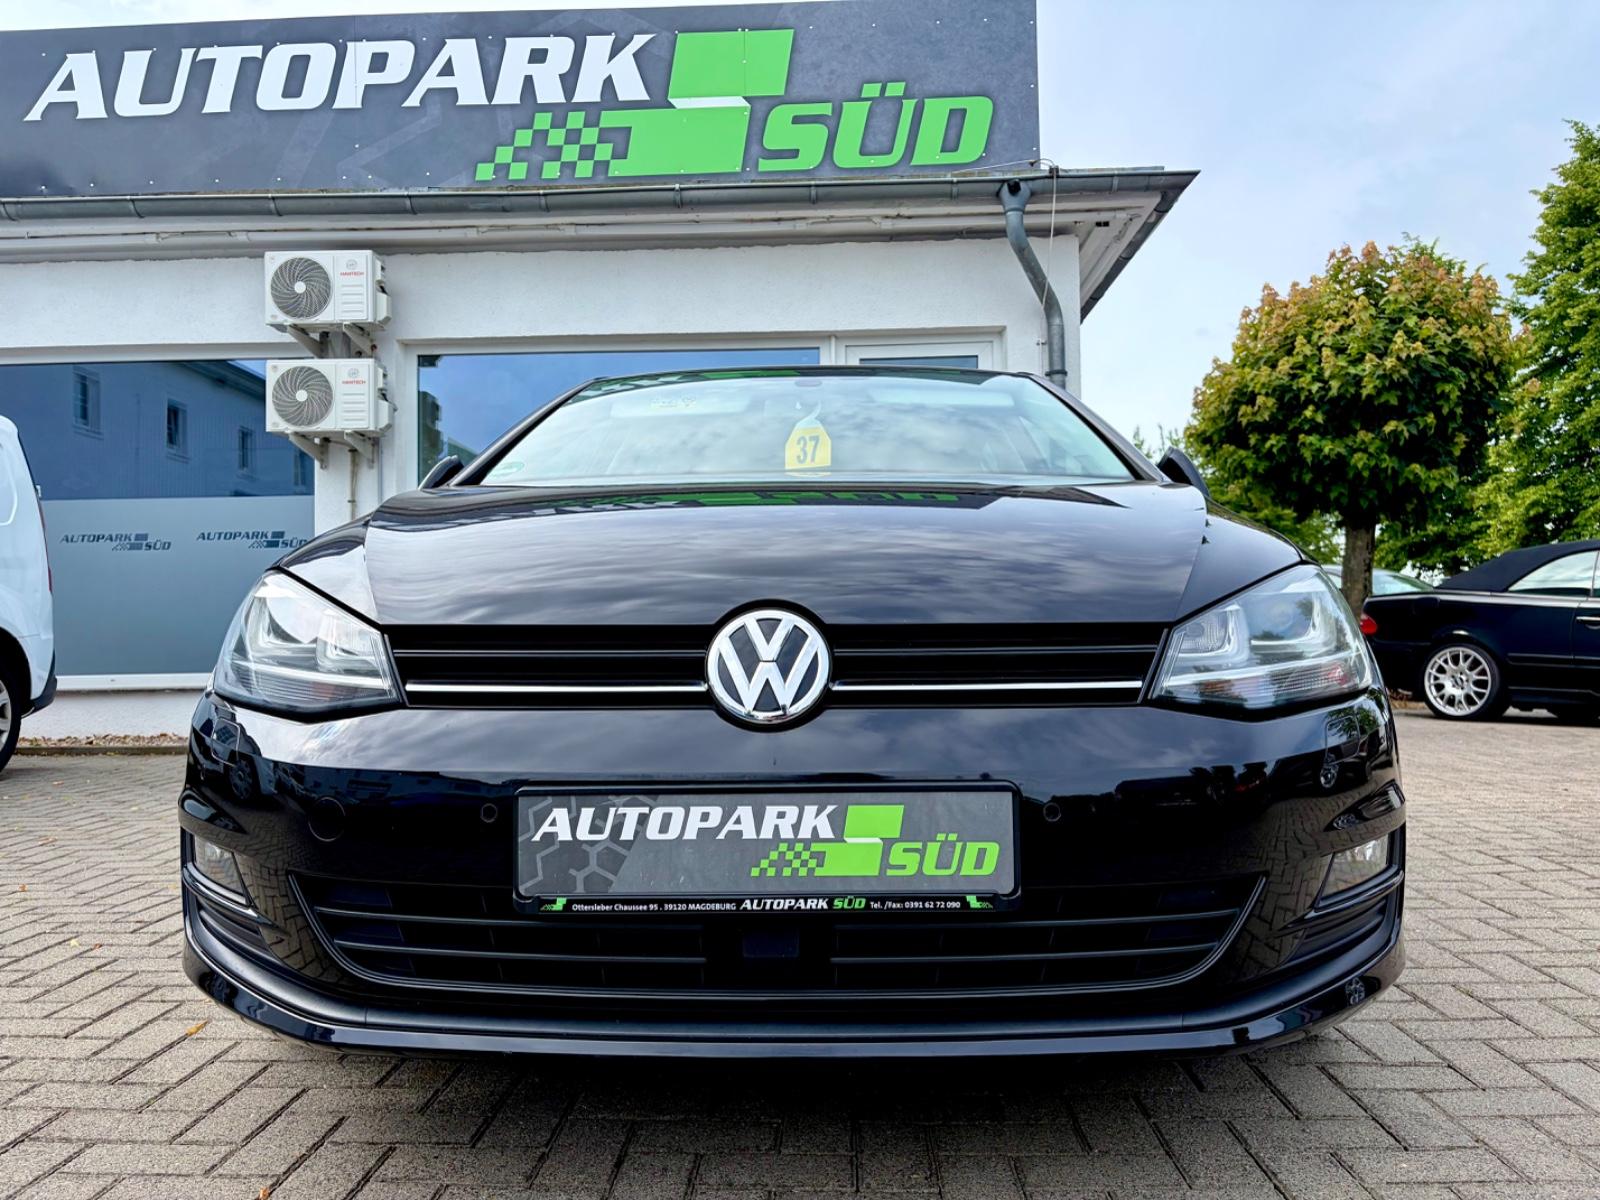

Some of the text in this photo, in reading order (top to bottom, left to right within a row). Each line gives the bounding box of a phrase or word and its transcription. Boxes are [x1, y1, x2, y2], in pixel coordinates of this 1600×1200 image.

[24, 33, 656, 121] AUTOPARK
[758, 82, 993, 172] SÜD
[796, 435, 820, 465] 37
[60, 533, 132, 543] AUTOPARK
[144, 539, 171, 551] SÜD
[196, 531, 269, 540] AUTOPARK
[531, 805, 838, 841] AUTOPARK
[886, 833, 1000, 876] SÜD
[614, 903, 648, 911] Chaussee
[649, 903, 658, 911] 95
[664, 903, 687, 911] 39120
[688, 902, 736, 910] MAGDEBURG
[740, 899, 829, 910] AUTOPARK
[833, 896, 866, 909] SÜD
[904, 901, 923, 909] 0391
[925, 901, 934, 909] 62
[936, 901, 945, 909] 72
[946, 901, 961, 909] 090
